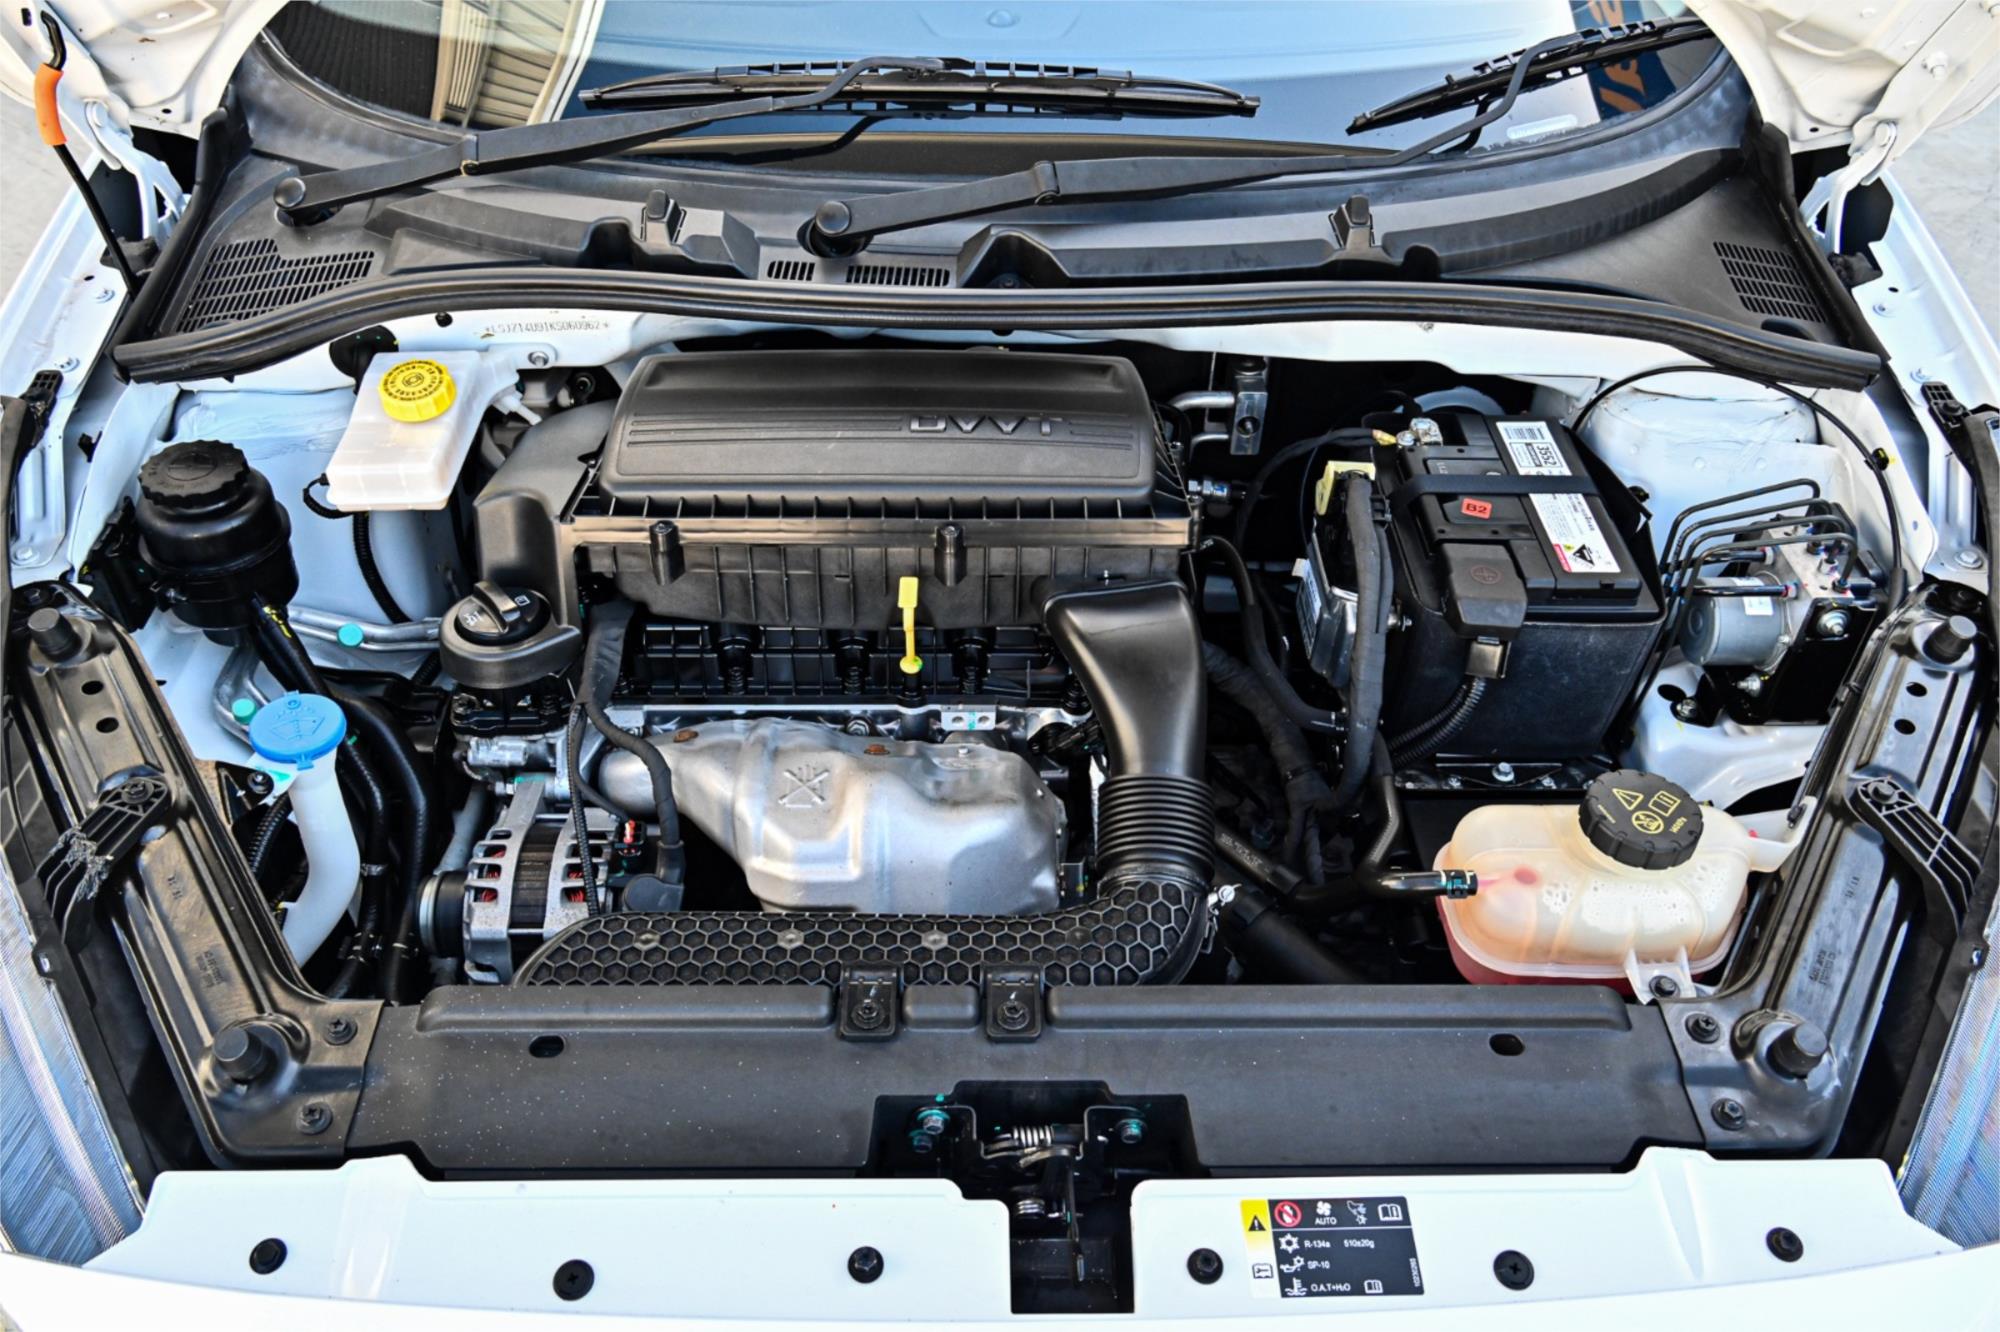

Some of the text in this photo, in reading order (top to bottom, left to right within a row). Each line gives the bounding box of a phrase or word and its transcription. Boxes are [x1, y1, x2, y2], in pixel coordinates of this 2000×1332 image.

[1536, 445, 1557, 466] 3552
[1466, 503, 1487, 514] B2
[1315, 1217, 1337, 1226] AUTO
[1304, 1239, 1331, 1249] R-134a
[1307, 1260, 1330, 1270] SP-10
